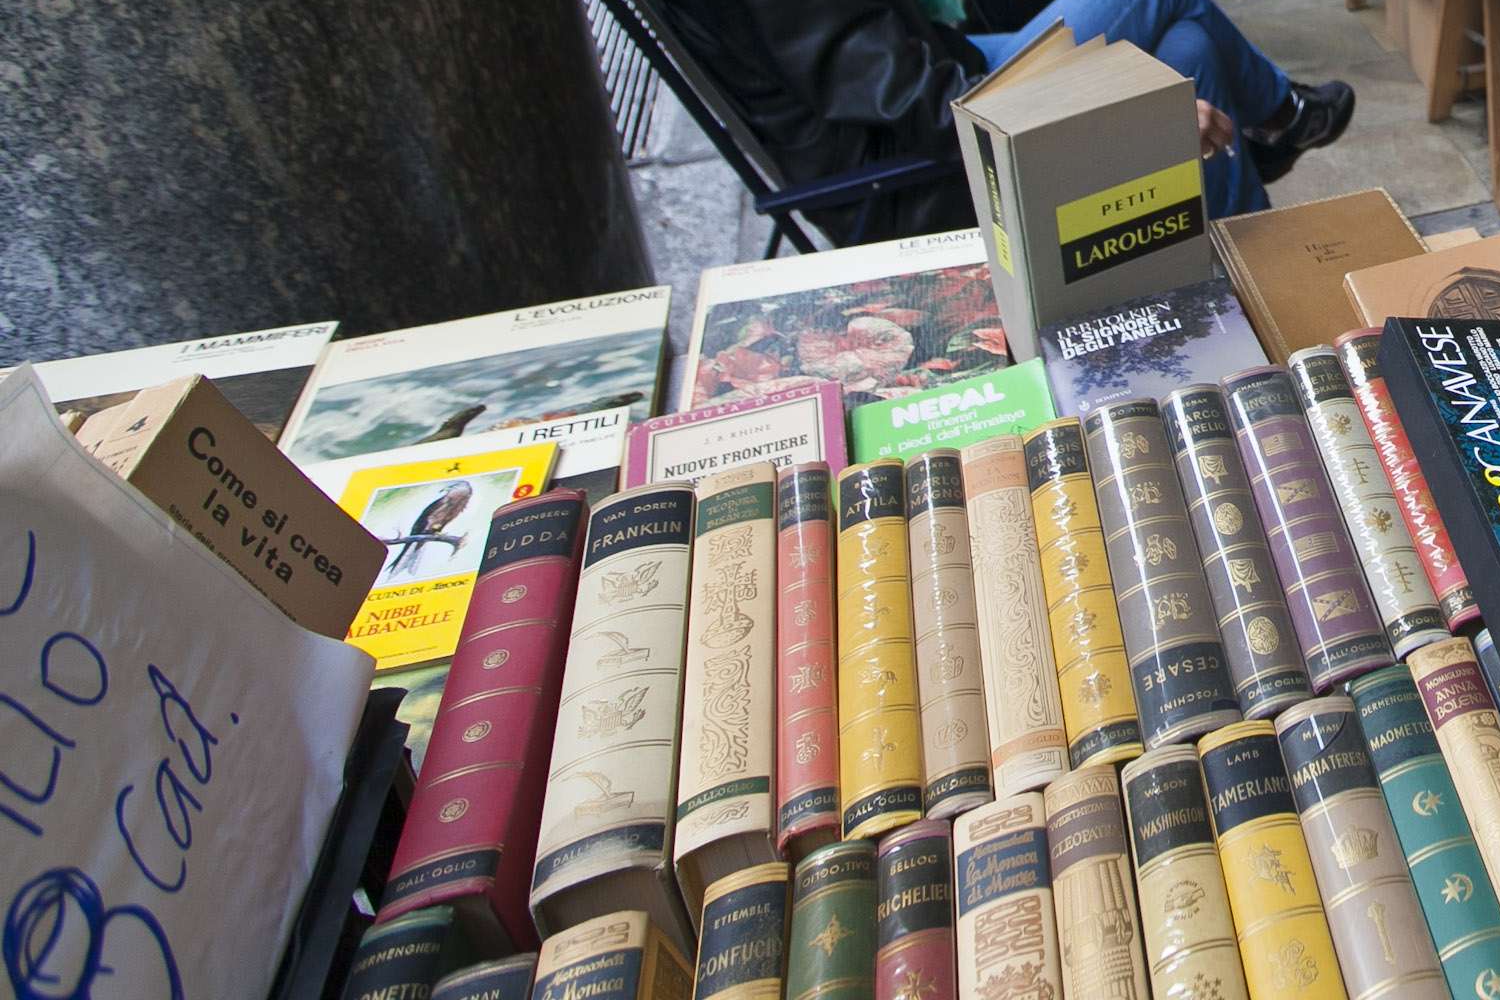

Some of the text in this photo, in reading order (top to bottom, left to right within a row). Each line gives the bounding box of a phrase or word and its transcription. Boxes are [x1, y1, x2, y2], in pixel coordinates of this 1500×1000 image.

[1101, 186, 1158, 216] PETIT
[900, 236, 922, 250] LE
[1075, 211, 1192, 269] LAROUSSE
[514, 289, 665, 322] L'EVOLUZIONE
[1062, 317, 1182, 360] DEGLI ANELLI
[1081, 314, 1160, 344] SIGNORE
[1469, 328, 1497, 371] LUCIANO GALLO
[650, 403, 740, 430] CULTURA
[890, 382, 1007, 428] NEPAL
[532, 414, 620, 442] RETTILI
[664, 456, 719, 479] NUOVE
[722, 433, 809, 464] FRONTIERE
[910, 488, 962, 510] MAGNO
[911, 476, 961, 494] CARLO
[187, 427, 258, 511] Come
[262, 508, 288, 534] si
[290, 534, 343, 587] crea
[501, 509, 571, 530] OLDENBERG
[603, 501, 678, 525] VAN DOREN
[203, 488, 294, 584] la vita
[488, 529, 570, 560] BUDDA
[592, 520, 683, 553] FRANKLIN
[366, 604, 422, 624] NIBBI
[1143, 655, 1219, 692] CESARE
[1158, 689, 1219, 714] FOSCHINI
[1434, 693, 1488, 721] BOLENA
[1435, 680, 1479, 704] ANNA
[1368, 720, 1435, 752] MAOMETTO
[1226, 748, 1260, 768] LAMB
[846, 792, 917, 824] DALL'OGLIO
[1210, 777, 1290, 813] TAMERLANO
[1138, 806, 1206, 841] WASHINGTON
[396, 858, 477, 892] DALL'OGLIO
[889, 853, 940, 877] BELLOC
[713, 902, 772, 930] ETIEMBLE
[698, 932, 784, 979] CONFUCIO
